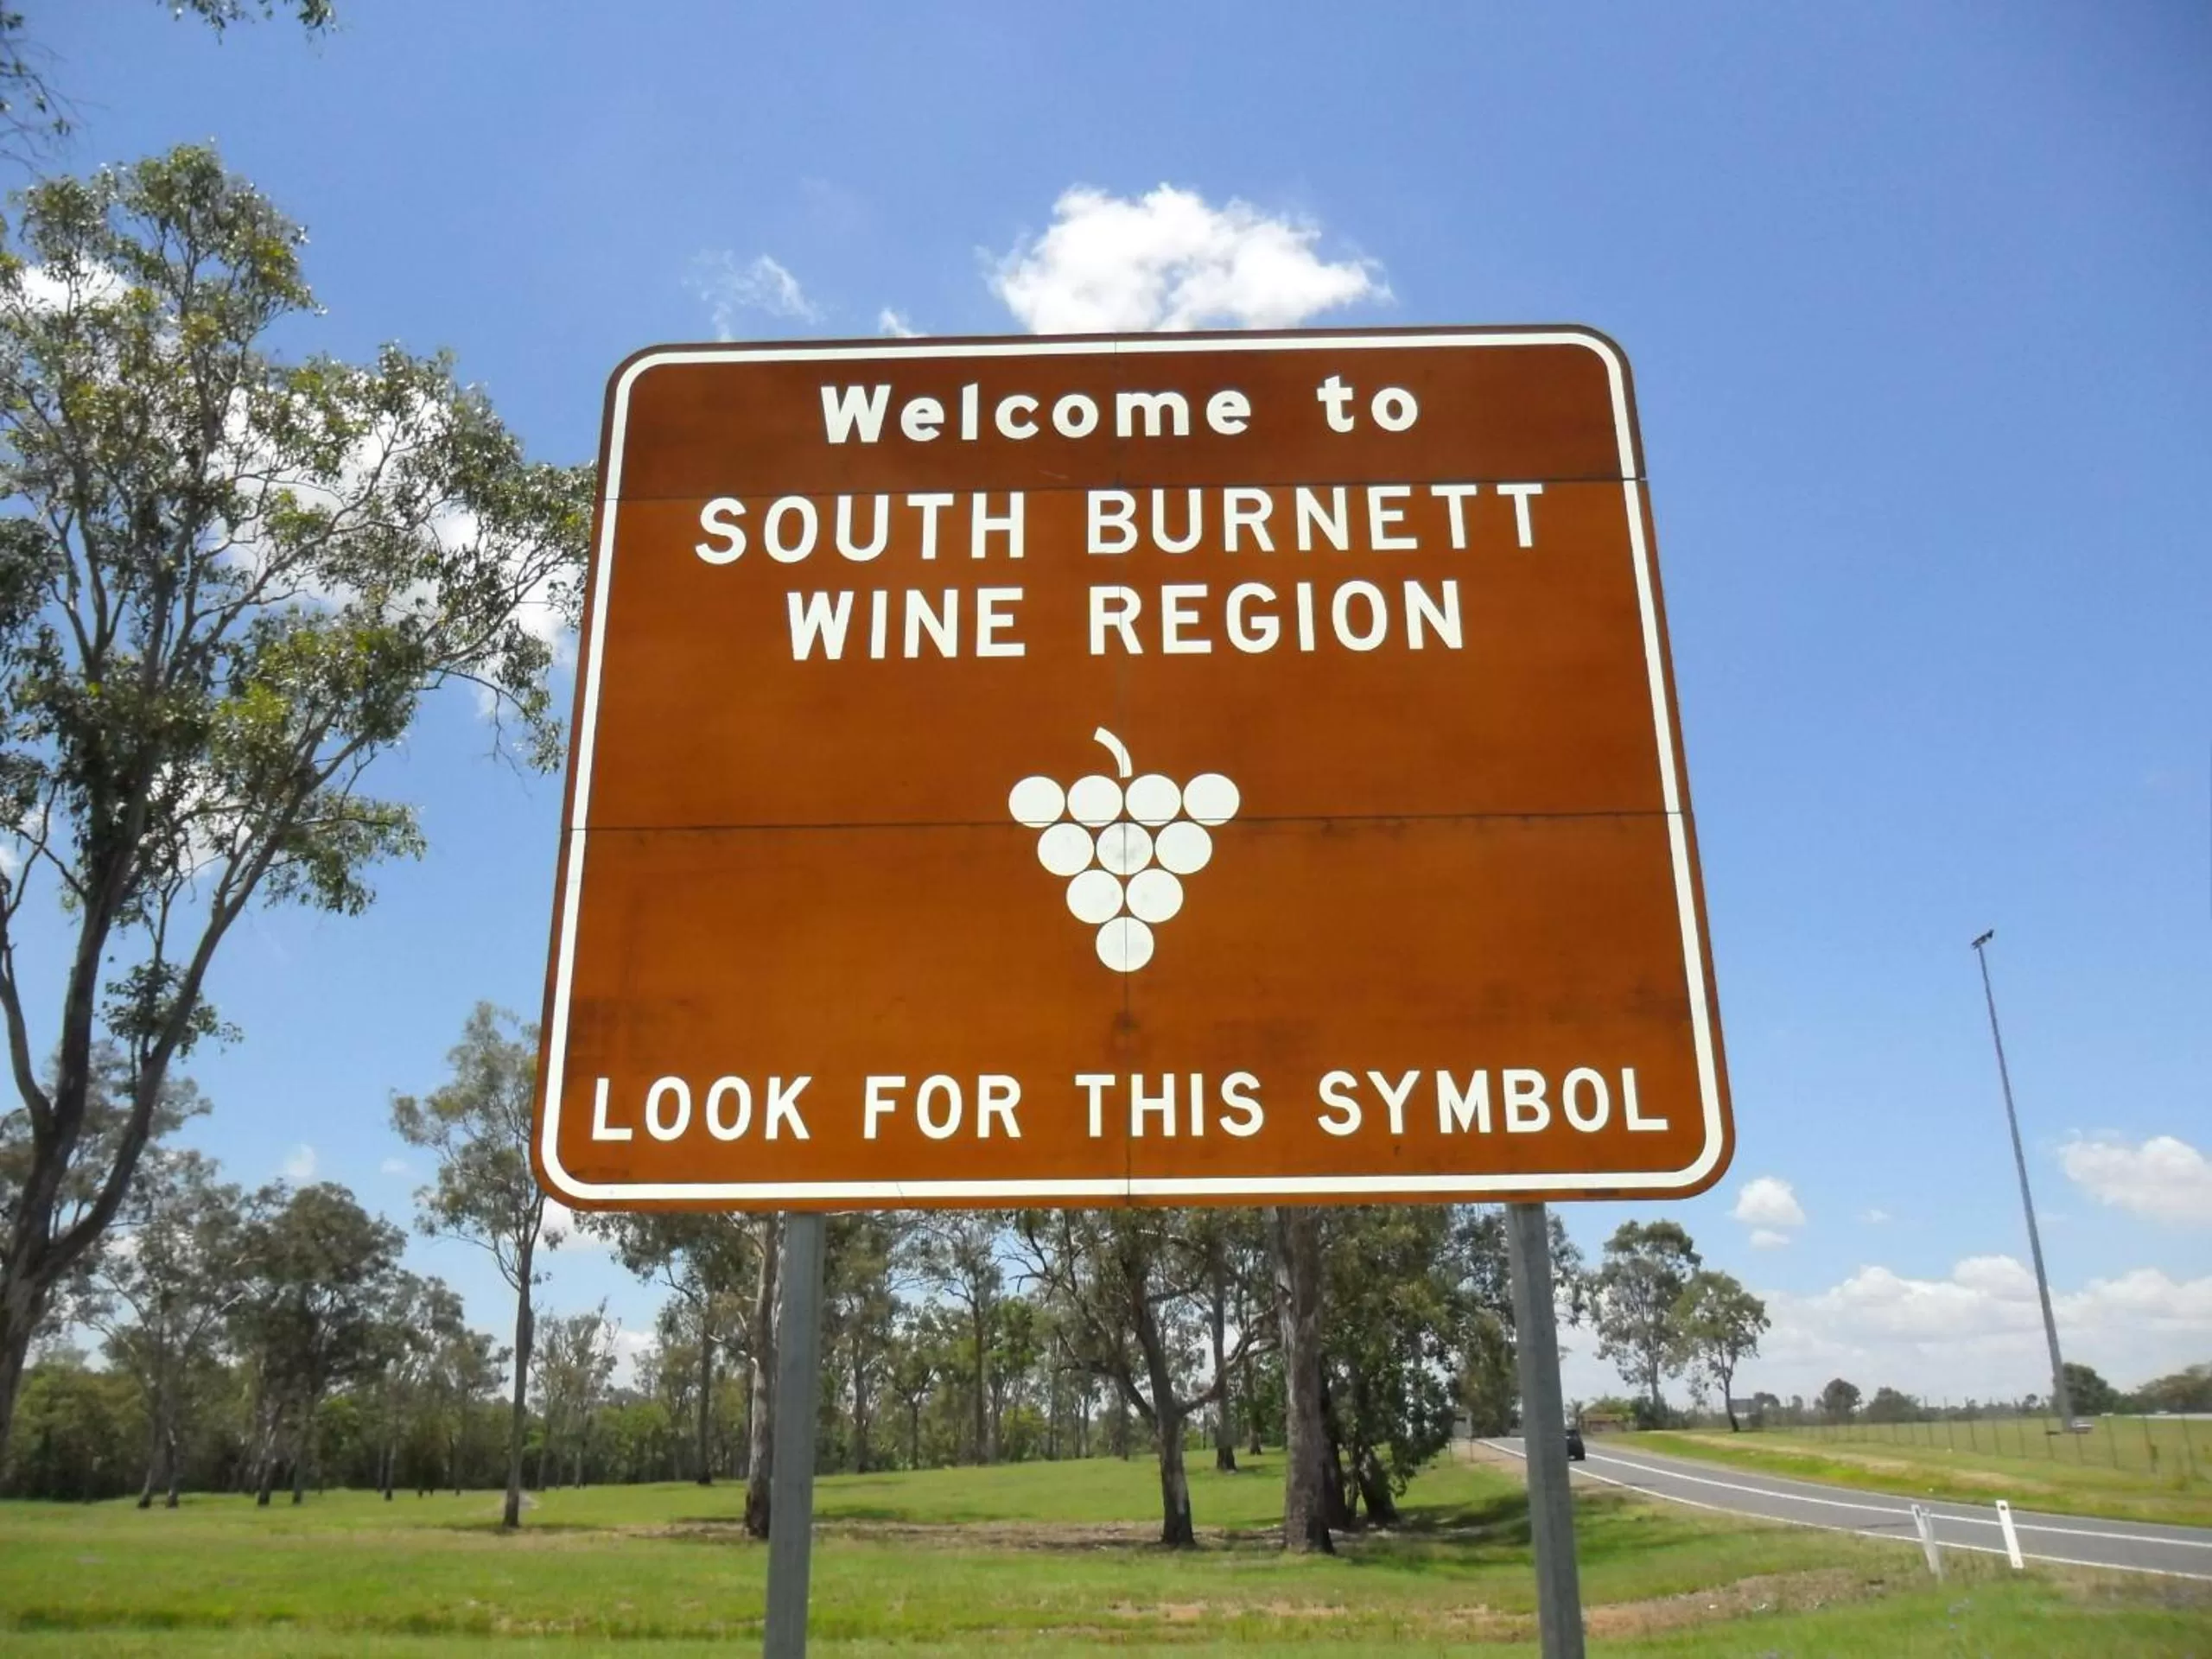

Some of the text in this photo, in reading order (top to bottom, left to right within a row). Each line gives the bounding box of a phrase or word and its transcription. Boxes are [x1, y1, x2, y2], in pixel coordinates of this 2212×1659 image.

[820, 374, 1419, 444] Welcome to
[695, 481, 1544, 565] SOUTH BURNETT
[786, 579, 1464, 661] WINE REGION
[591, 1066, 1669, 1142] LOOK FOR THIS SYMBOL
